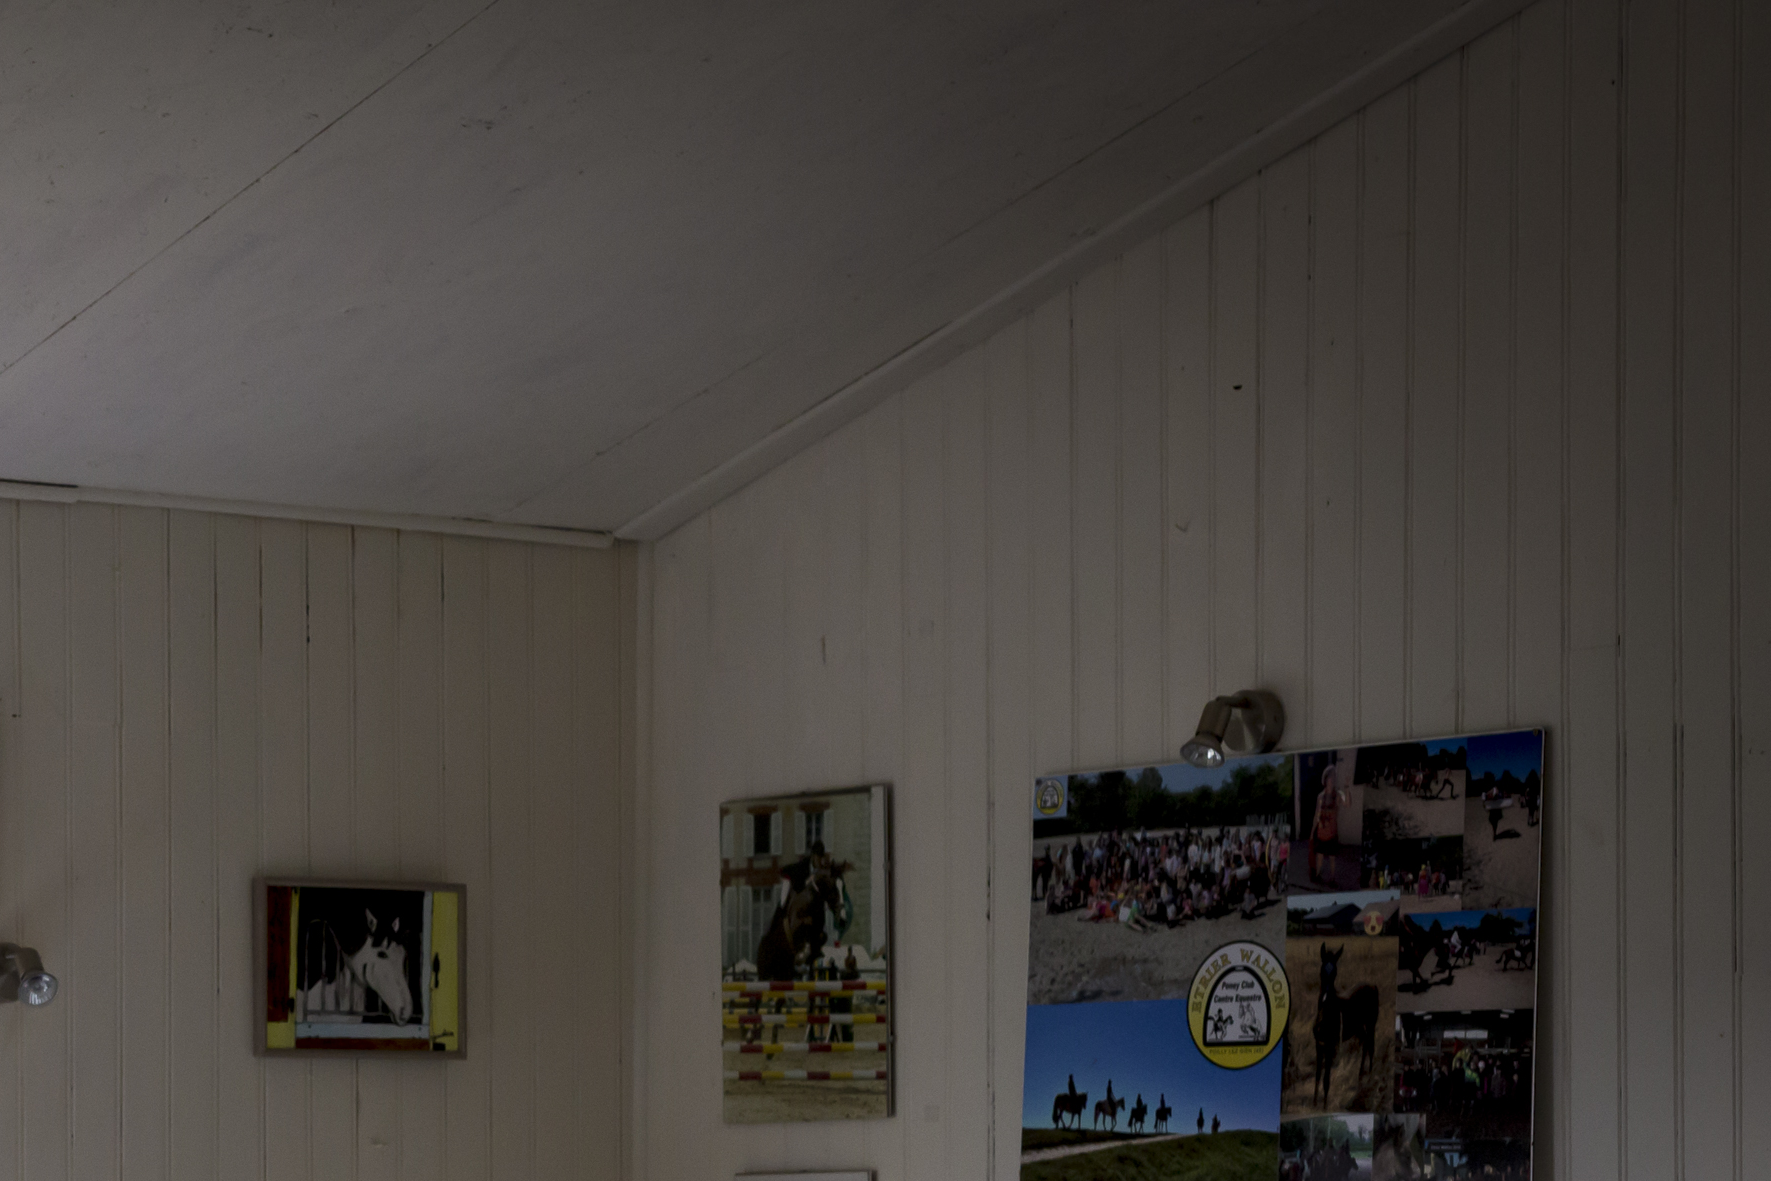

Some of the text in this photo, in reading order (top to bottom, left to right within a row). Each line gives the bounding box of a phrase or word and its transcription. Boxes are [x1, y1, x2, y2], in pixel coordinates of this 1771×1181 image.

[1191, 948, 1286, 1014] ETRIER WALLON
[1222, 980, 1254, 991] Poney Club
[1213, 995, 1233, 1003] Centre
